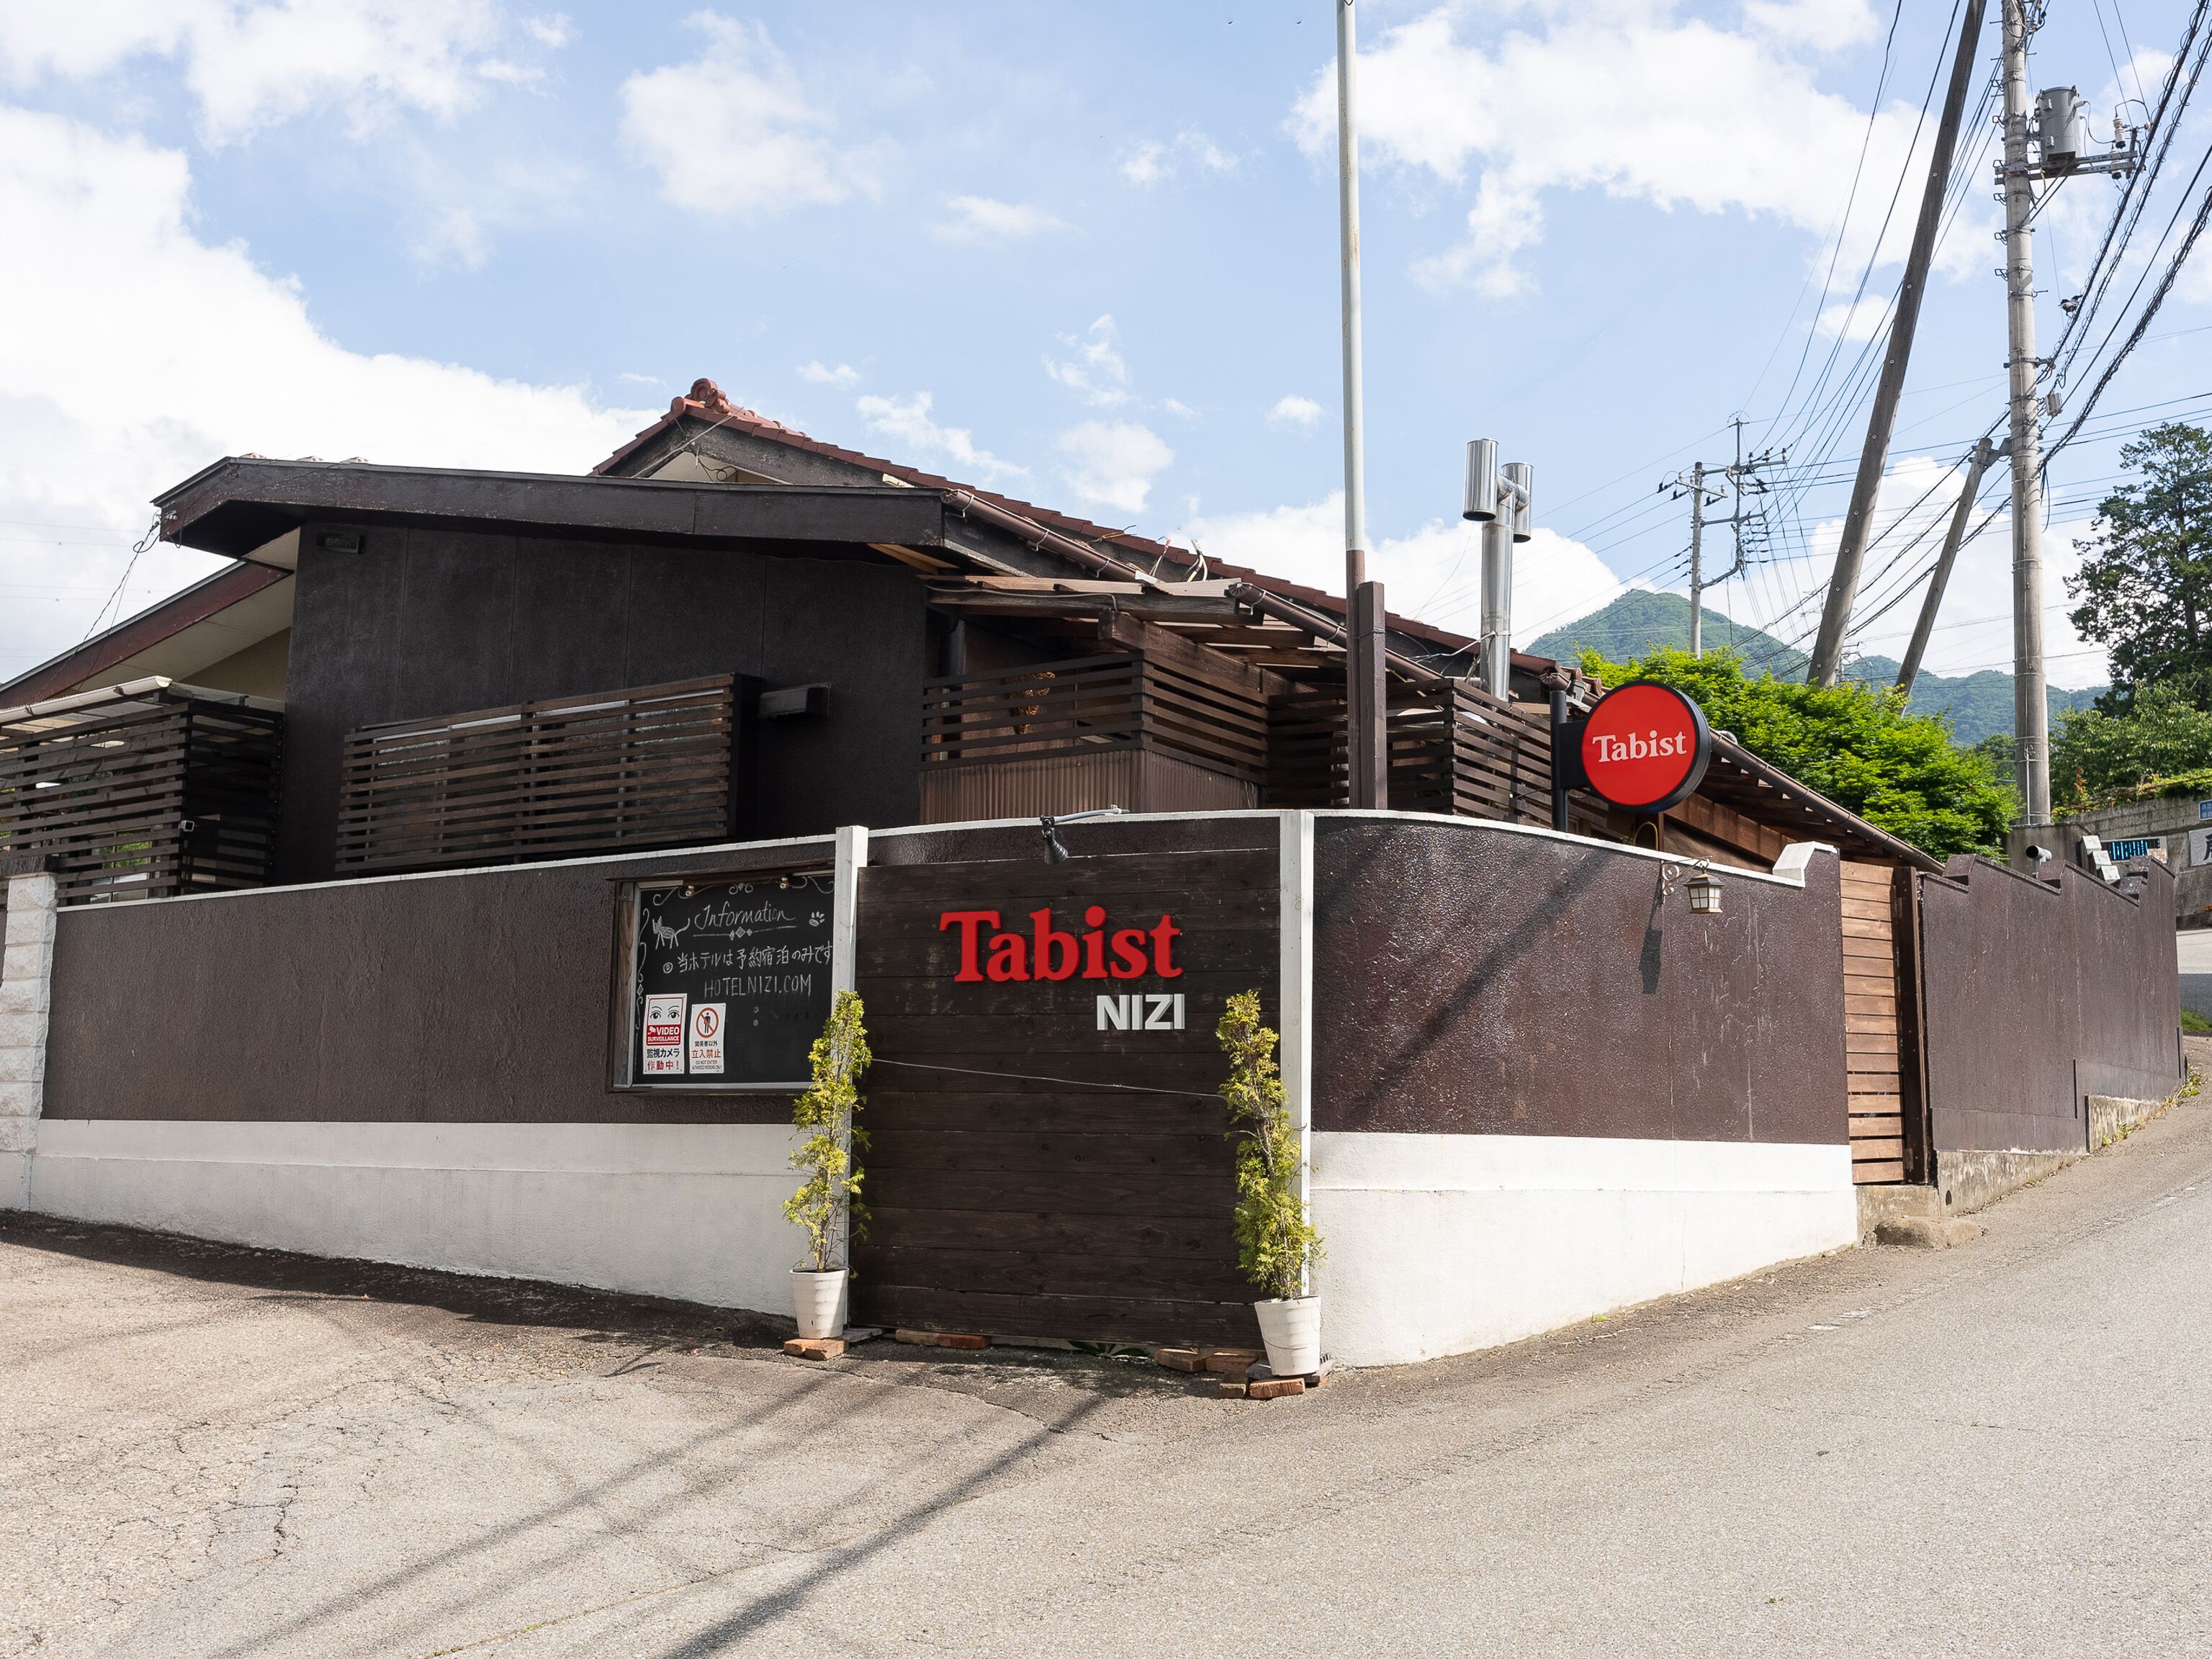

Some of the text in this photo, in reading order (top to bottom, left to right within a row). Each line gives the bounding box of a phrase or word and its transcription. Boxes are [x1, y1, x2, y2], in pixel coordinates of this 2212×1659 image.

[1592, 730, 1687, 763] Tabist
[695, 901, 796, 930] Information
[678, 940, 832, 973] 当ホテルは予約宿泊のみです
[939, 905, 1184, 982] Tabist
[704, 974, 811, 998] HOTELNIZI.COM
[1097, 994, 1185, 1030] NIZI
[656, 1026, 680, 1035] VIDEO
[647, 1048, 680, 1058] 監視カメラ
[691, 1049, 721, 1058] 立入禁止
